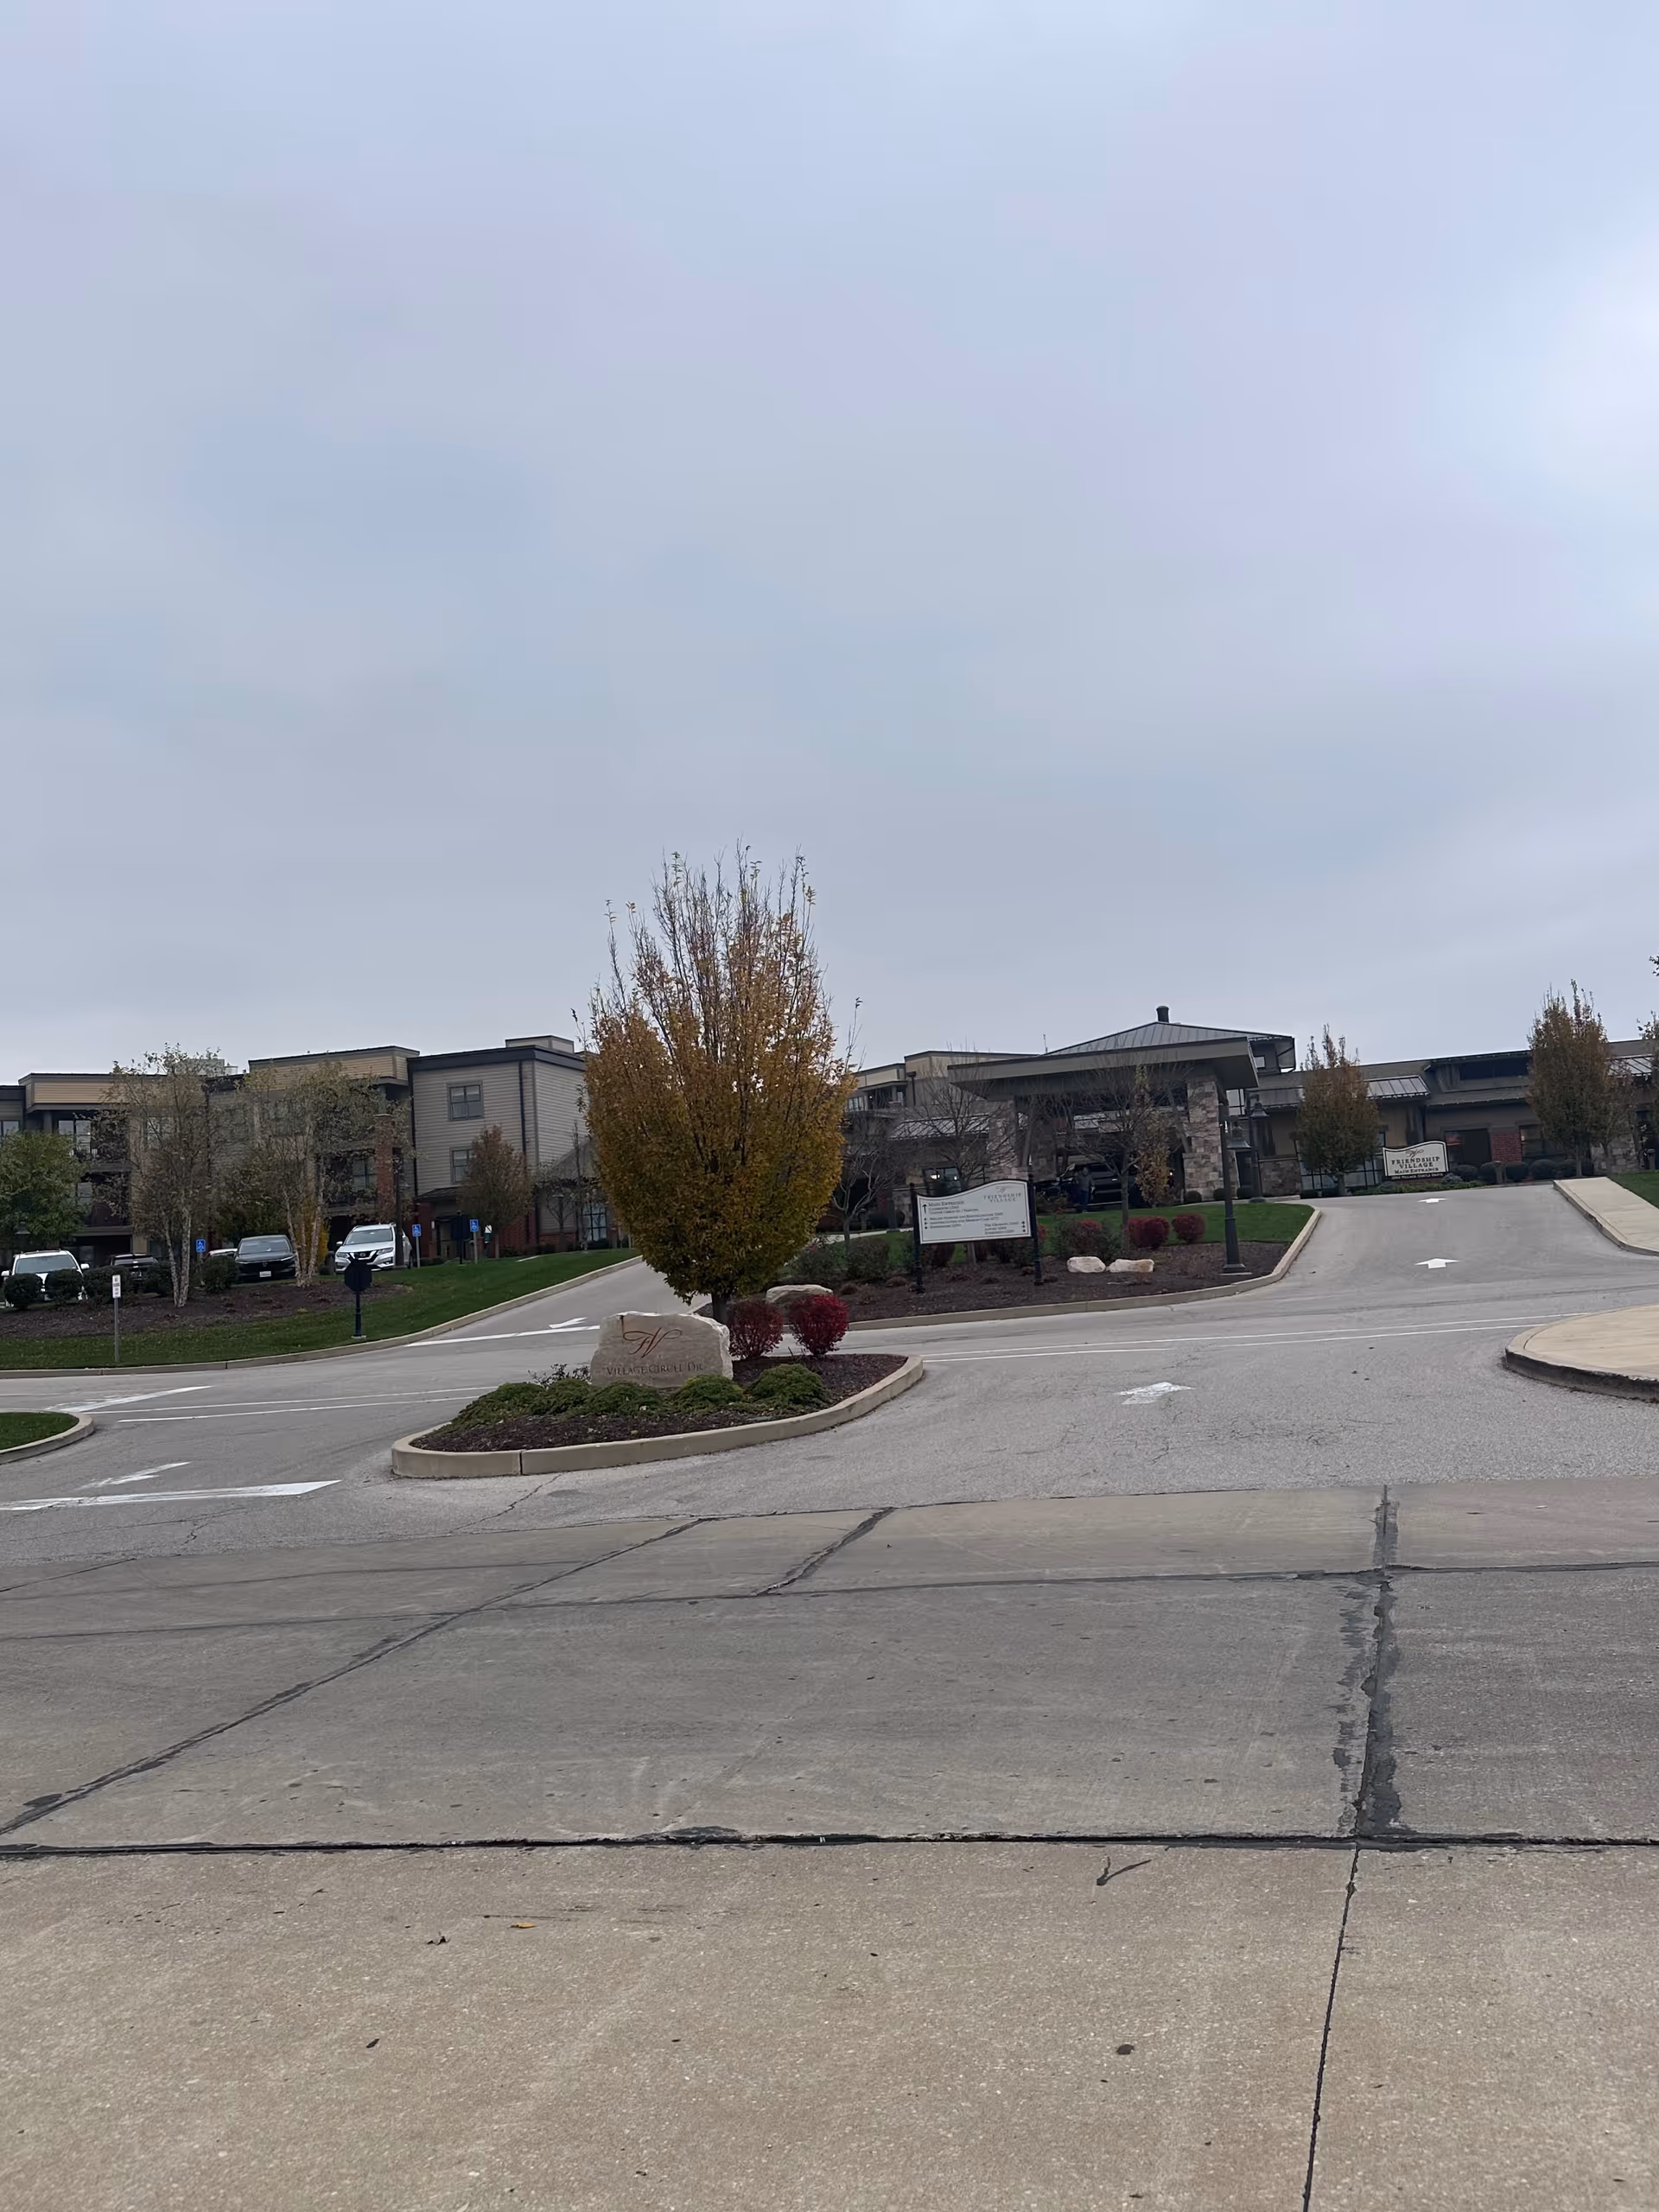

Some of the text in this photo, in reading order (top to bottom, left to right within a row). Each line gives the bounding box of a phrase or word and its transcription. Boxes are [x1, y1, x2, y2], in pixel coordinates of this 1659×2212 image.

[1391, 1156, 1440, 1165] FRIENDSHIP
[607, 1366, 648, 1376] VILLAGE
[649, 1363, 683, 1374] CIRCLE
